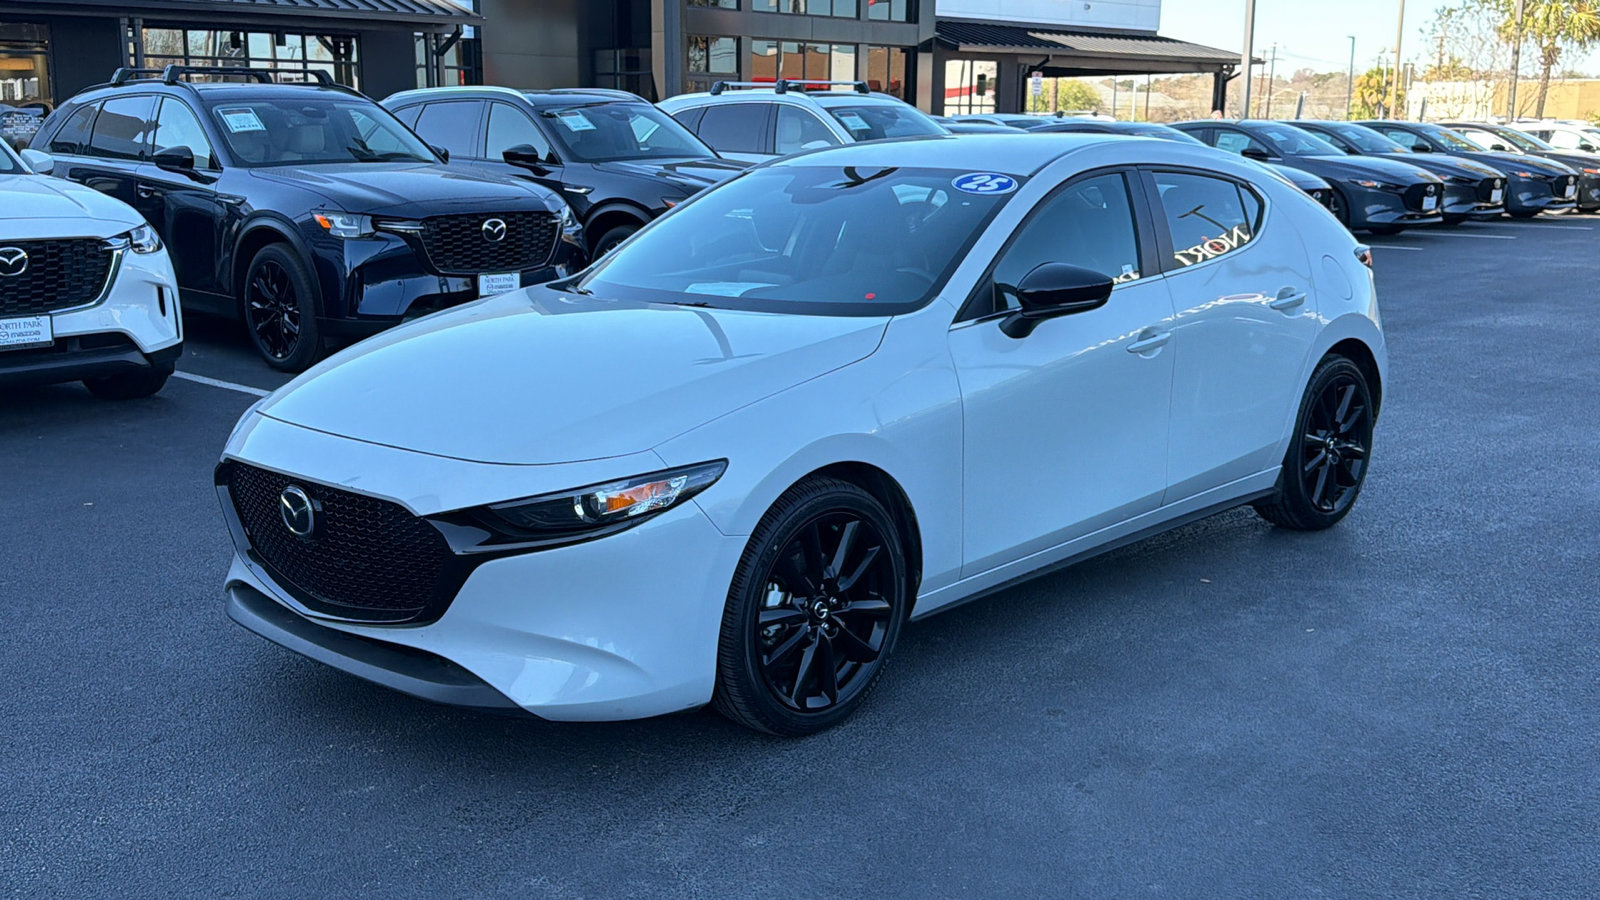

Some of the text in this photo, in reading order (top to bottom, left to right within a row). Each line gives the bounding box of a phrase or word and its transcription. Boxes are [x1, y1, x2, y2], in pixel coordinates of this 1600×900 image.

[961, 175, 1009, 191] 25
[0, 320, 43, 330] ORTH PARK
[11, 330, 41, 338] mazda
